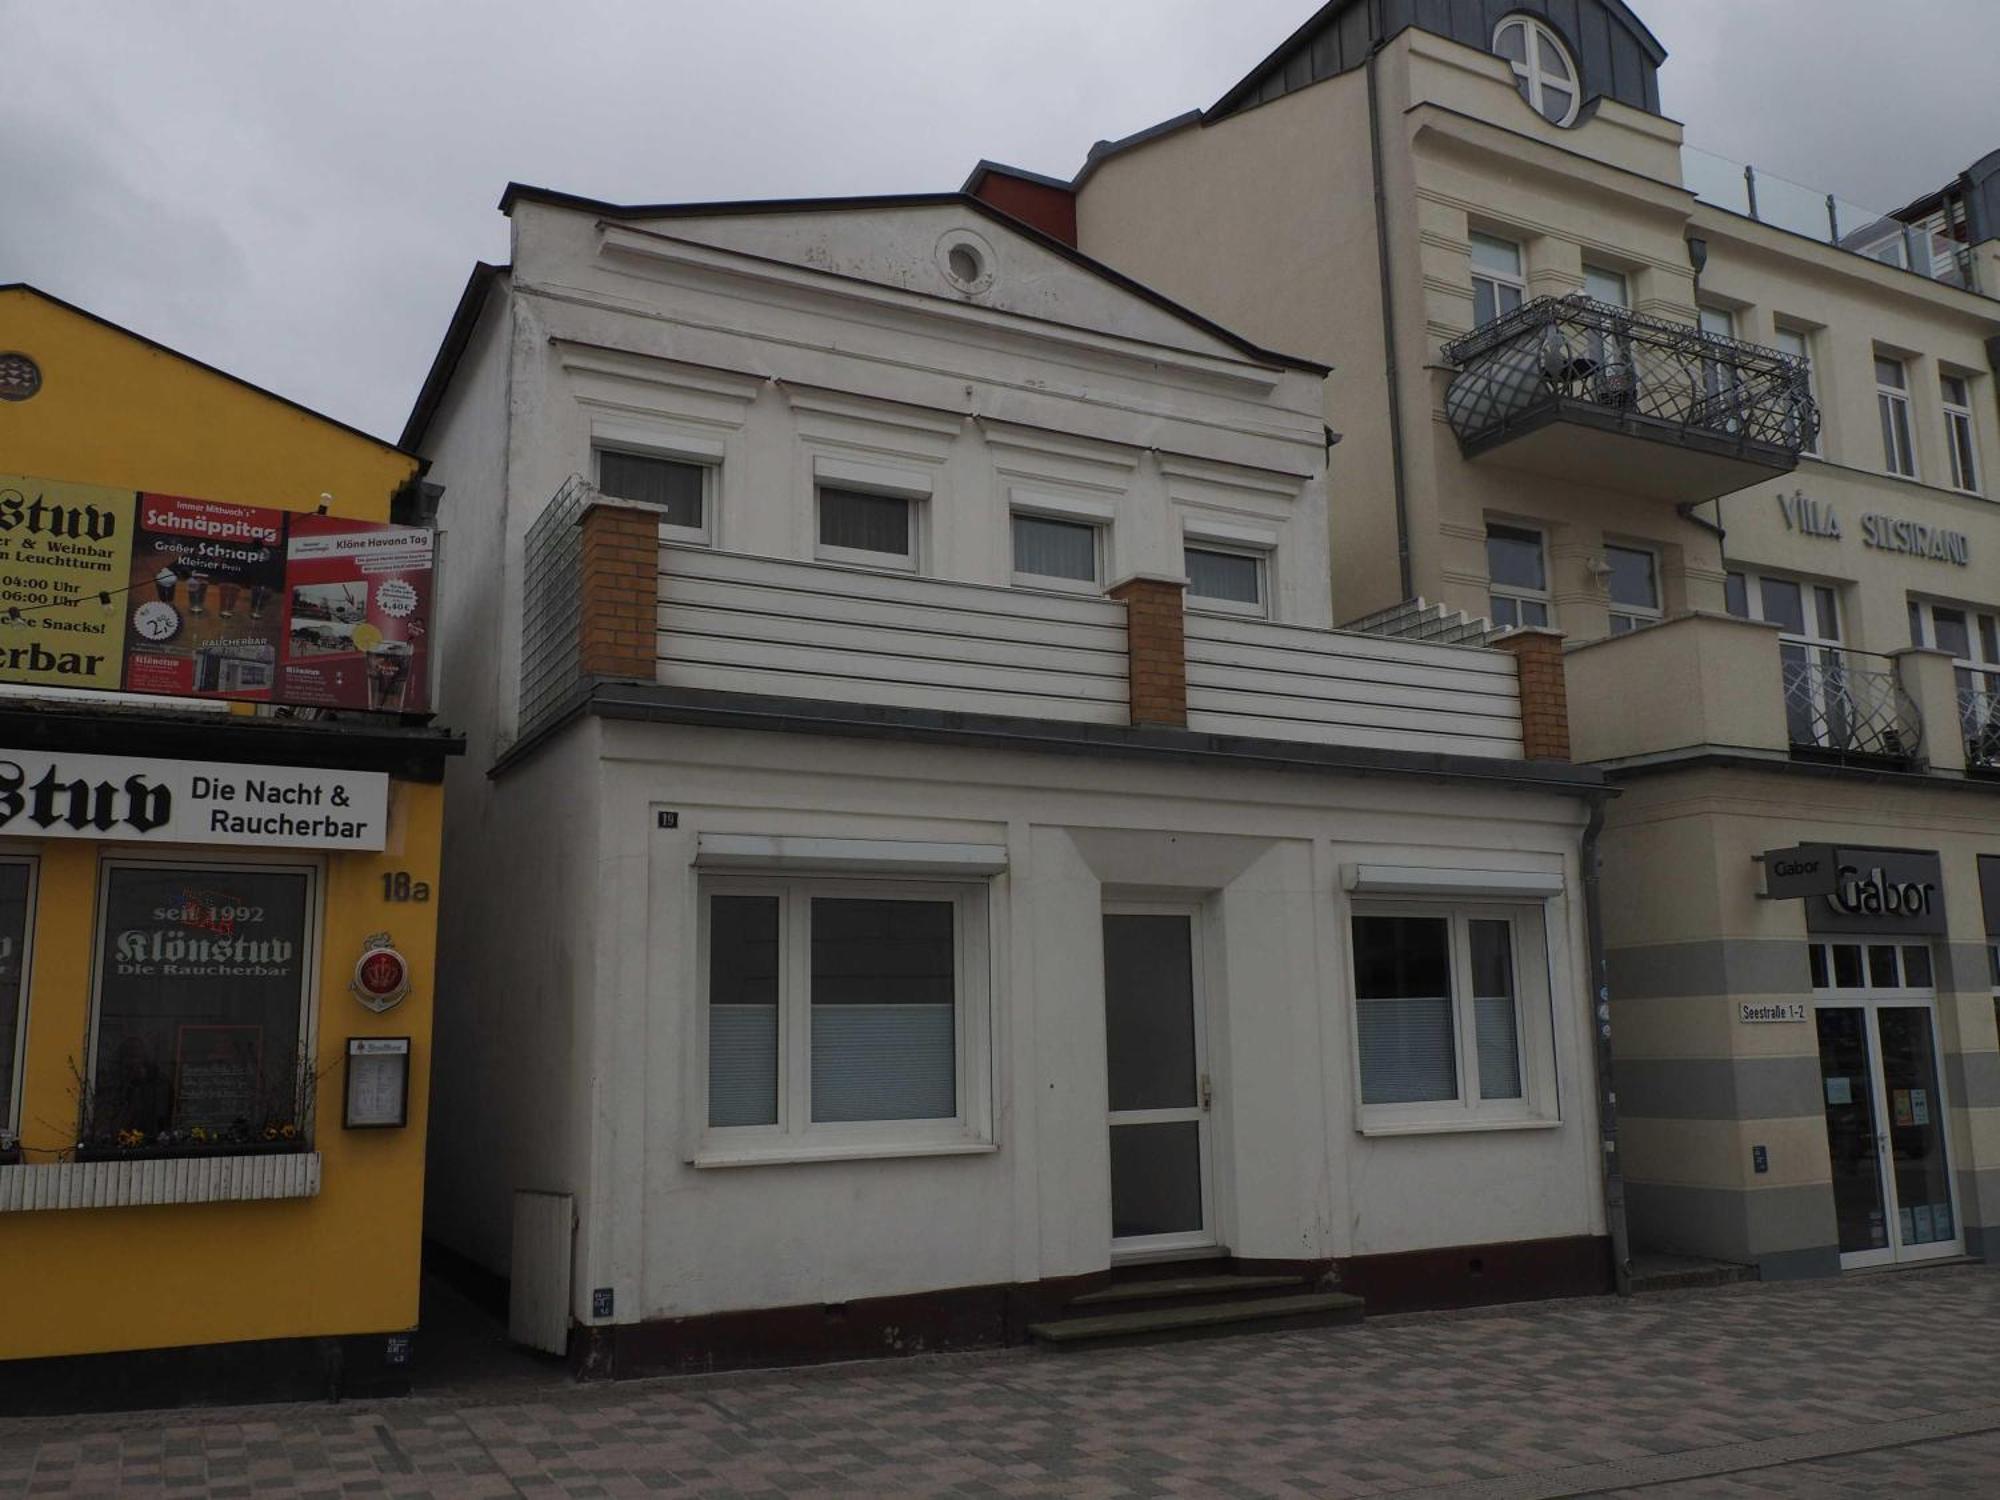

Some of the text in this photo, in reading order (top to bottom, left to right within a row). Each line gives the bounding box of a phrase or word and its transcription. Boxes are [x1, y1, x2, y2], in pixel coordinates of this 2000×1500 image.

[22, 538, 37, 548] &
[48, 541, 114, 559] Weinbar
[154, 541, 195, 554] Großer
[367, 537, 408, 548] Havana
[409, 535, 429, 546] Tag
[16, 551, 112, 572] Leuchtturm
[2, 576, 81, 594] 04:00 Uhr
[2, 590, 80, 608] 06:00 Uhr
[42, 617, 106, 635] Snacks!
[192, 776, 351, 807] Die Nacht &
[210, 810, 369, 839] Raucherbar
[1774, 860, 1820, 877] Gabor
[382, 872, 430, 902] 18a
[1828, 864, 1935, 916] Gabor
[207, 905, 265, 923] 1992
[117, 964, 291, 976] Die Raucherbar
[1743, 1004, 1806, 1020] Seestraße 1-2
